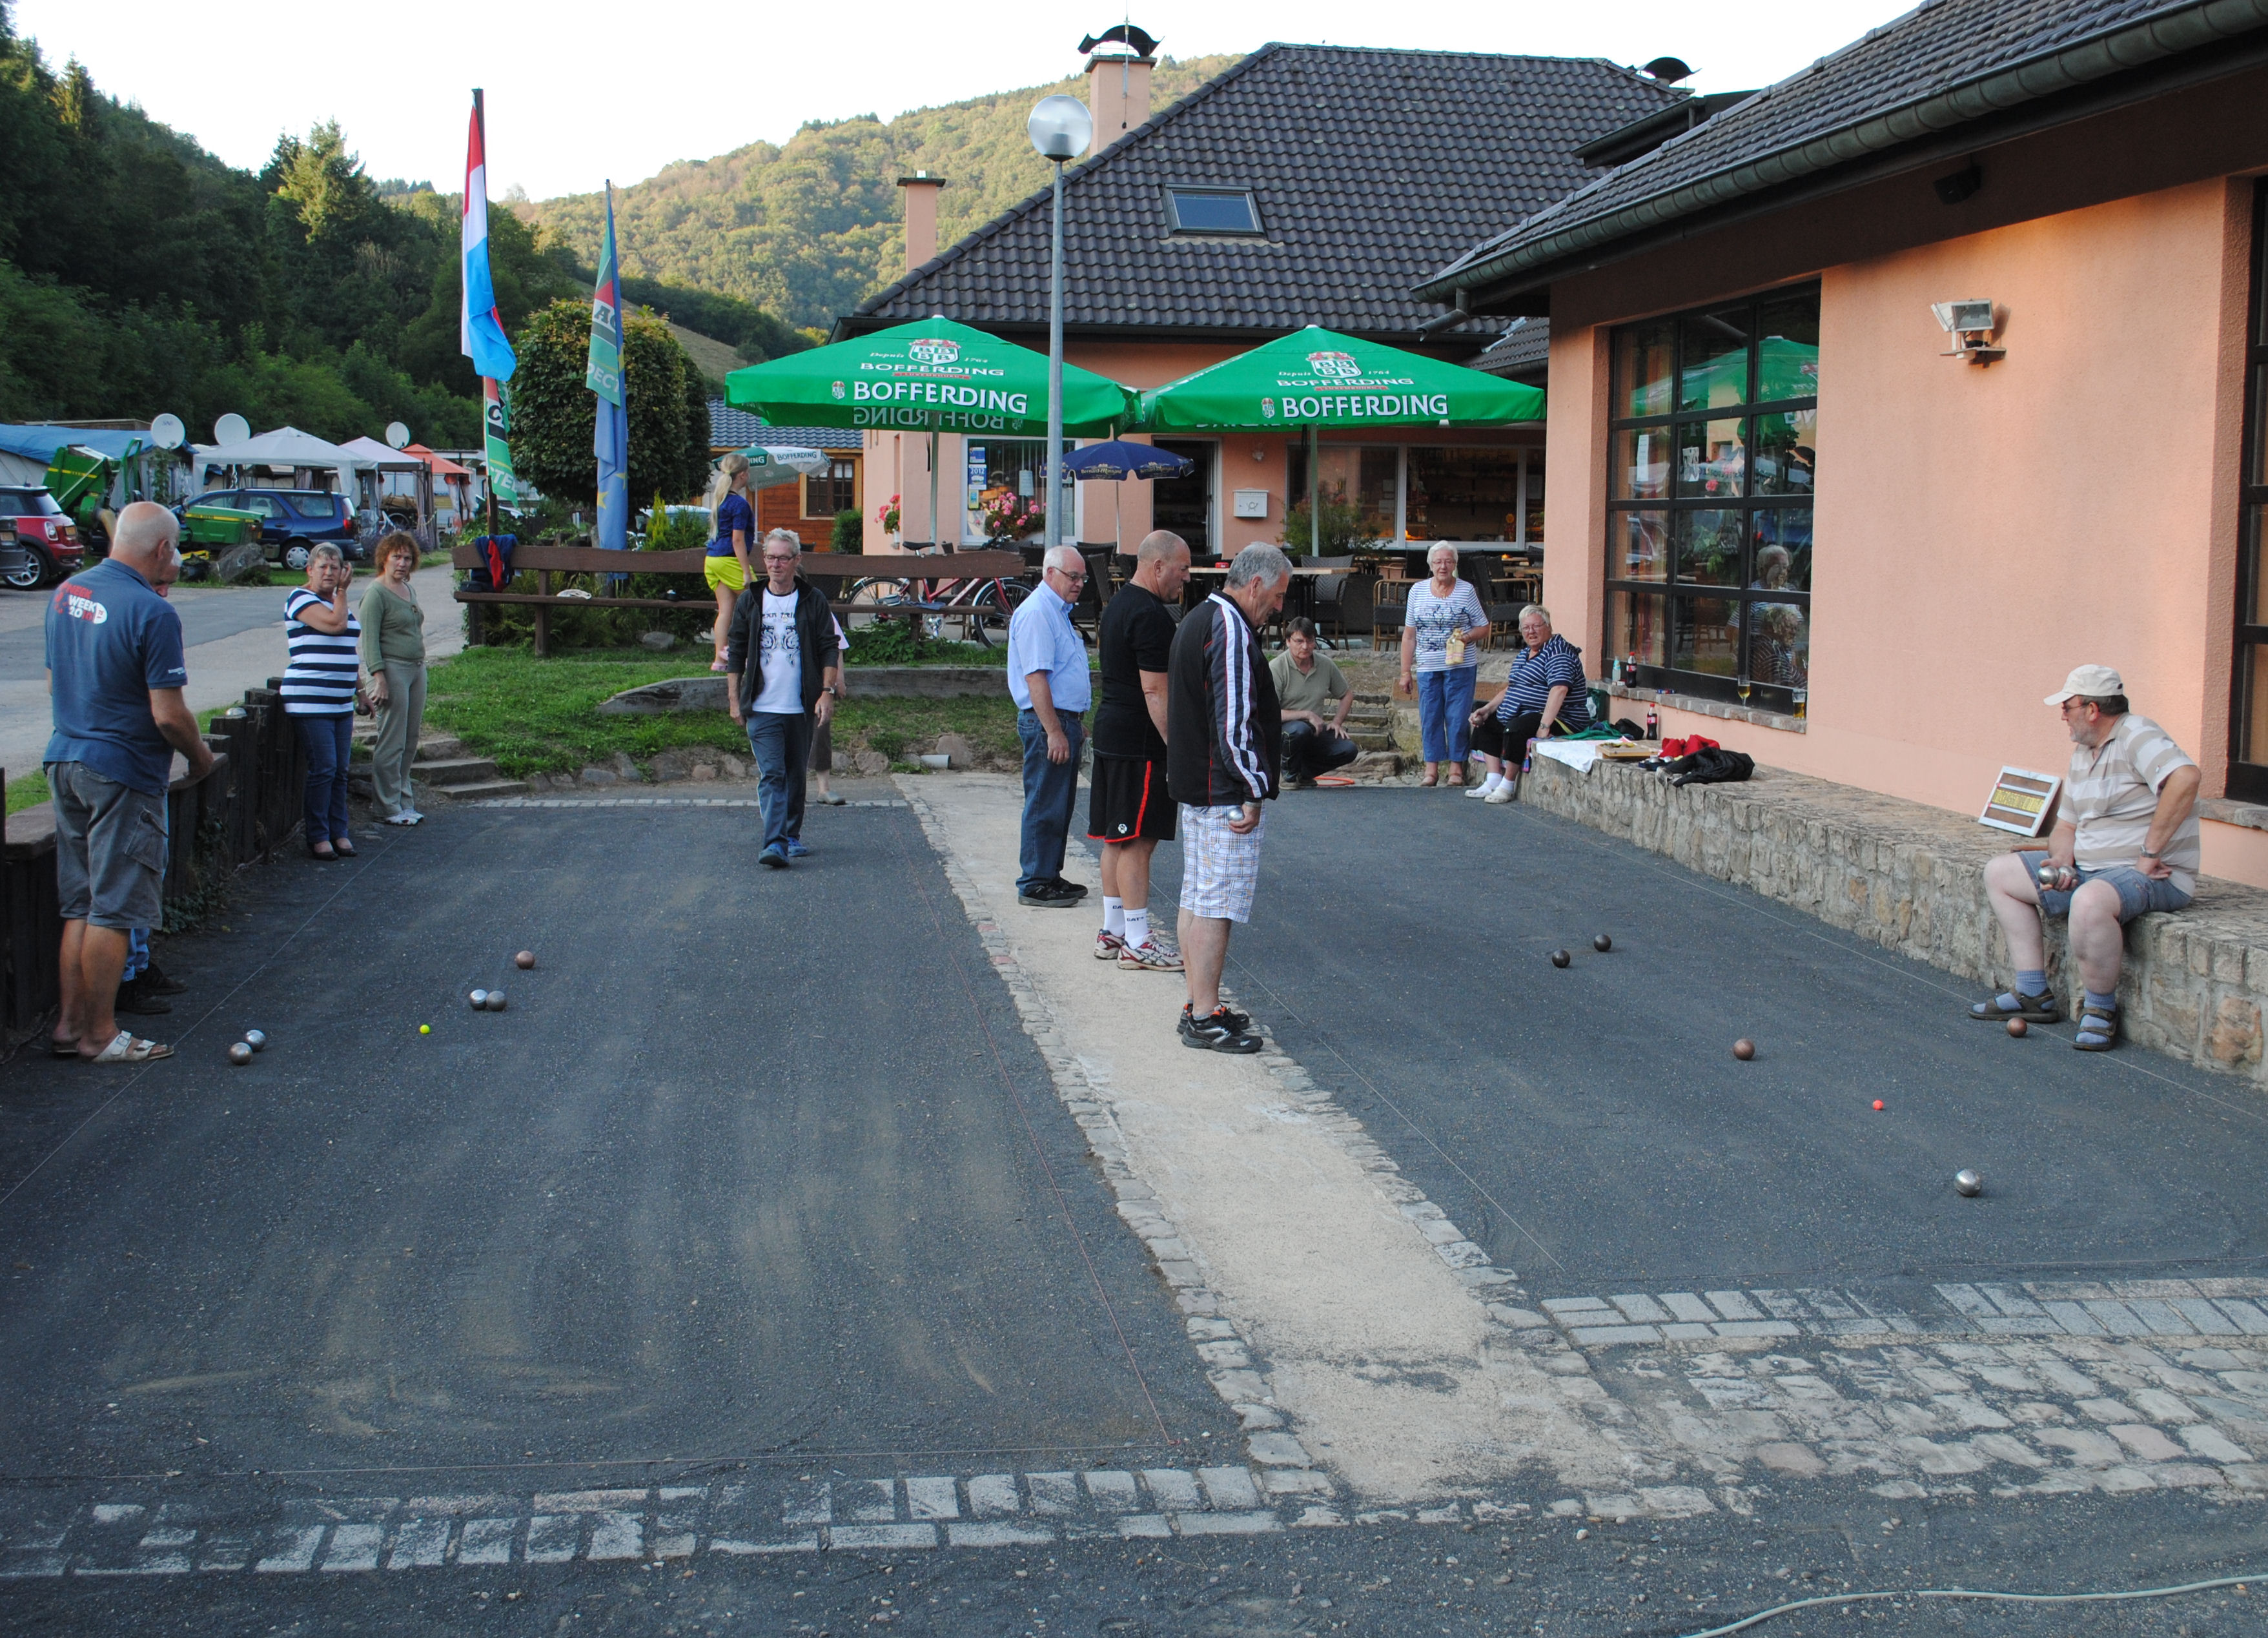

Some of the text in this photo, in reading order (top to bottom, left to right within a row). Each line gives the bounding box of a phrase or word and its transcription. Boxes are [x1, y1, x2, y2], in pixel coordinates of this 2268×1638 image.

[860, 363, 1005, 376] BOFFERDING
[1276, 378, 1415, 387] BOFFERDING
[853, 381, 1028, 415] BOFFERDING
[1282, 394, 1448, 418] BOFFERDING
[777, 452, 817, 461] BOFFERDING
[68, 594, 96, 613] WEEK
